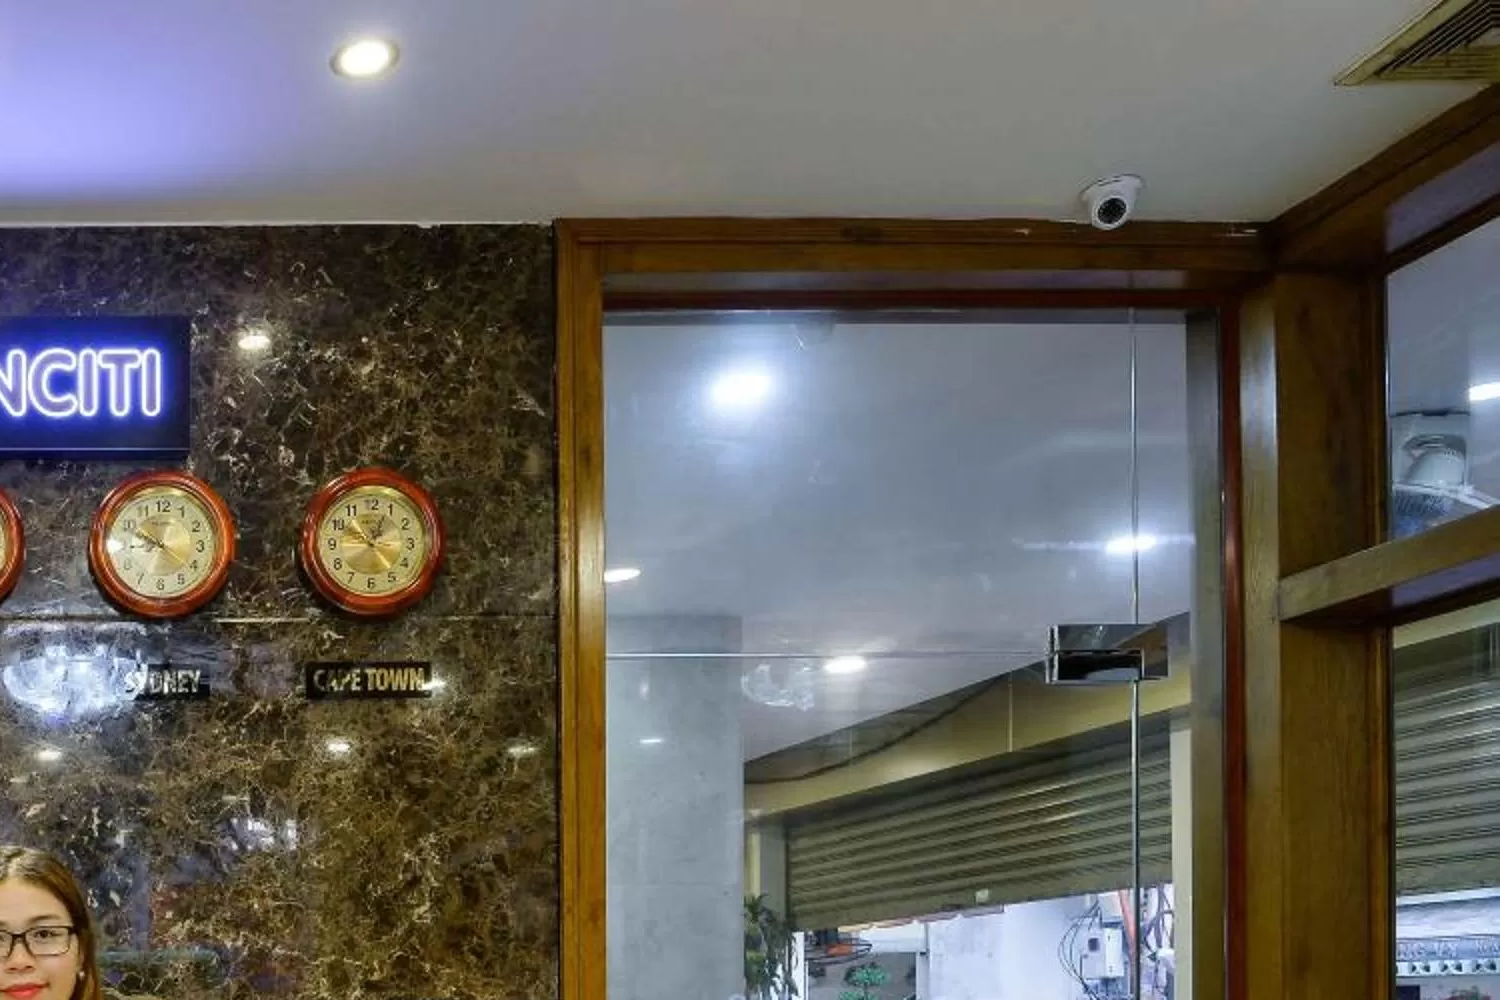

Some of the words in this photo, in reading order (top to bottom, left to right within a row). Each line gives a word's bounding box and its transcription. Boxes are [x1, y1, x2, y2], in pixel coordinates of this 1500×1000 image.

[155, 500, 171, 513] 12
[177, 505, 186, 517] 1
[345, 504, 357, 517] 11
[388, 504, 394, 516] 1
[192, 520, 201, 533] 2
[401, 517, 410, 530] 2
[195, 540, 205, 553] 3
[328, 538, 337, 550] 9
[406, 537, 415, 550] 3
[189, 559, 198, 571] 4
[333, 558, 342, 570] 8
[399, 558, 408, 569] 4
[177, 573, 186, 585] 5
[347, 572, 356, 583] 7
[367, 577, 375, 589] 6
[387, 572, 397, 583] 5
[156, 578, 165, 591] 6
[365, 667, 426, 691] TOWN
